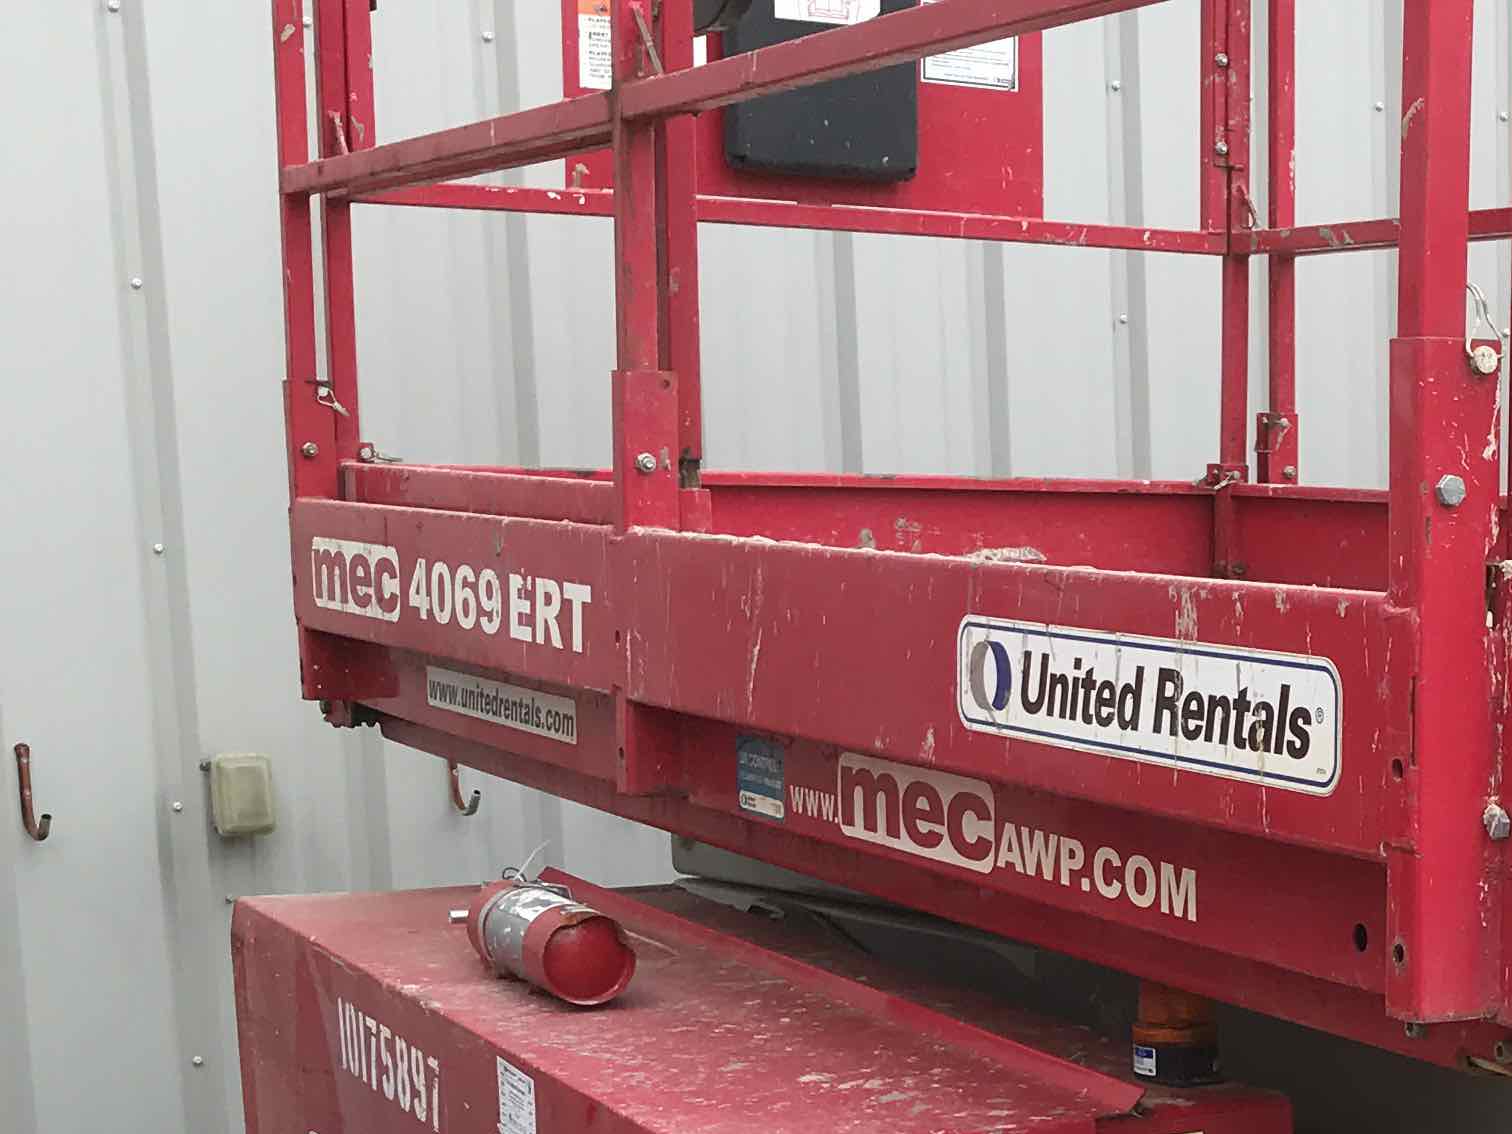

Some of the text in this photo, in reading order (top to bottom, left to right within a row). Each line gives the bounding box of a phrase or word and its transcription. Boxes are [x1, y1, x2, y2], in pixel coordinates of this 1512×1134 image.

[311, 547, 399, 613] mec
[428, 679, 575, 737] www.unitedrentals.com
[1021, 650, 1145, 732] United
[337, 996, 441, 1134] 10175897
